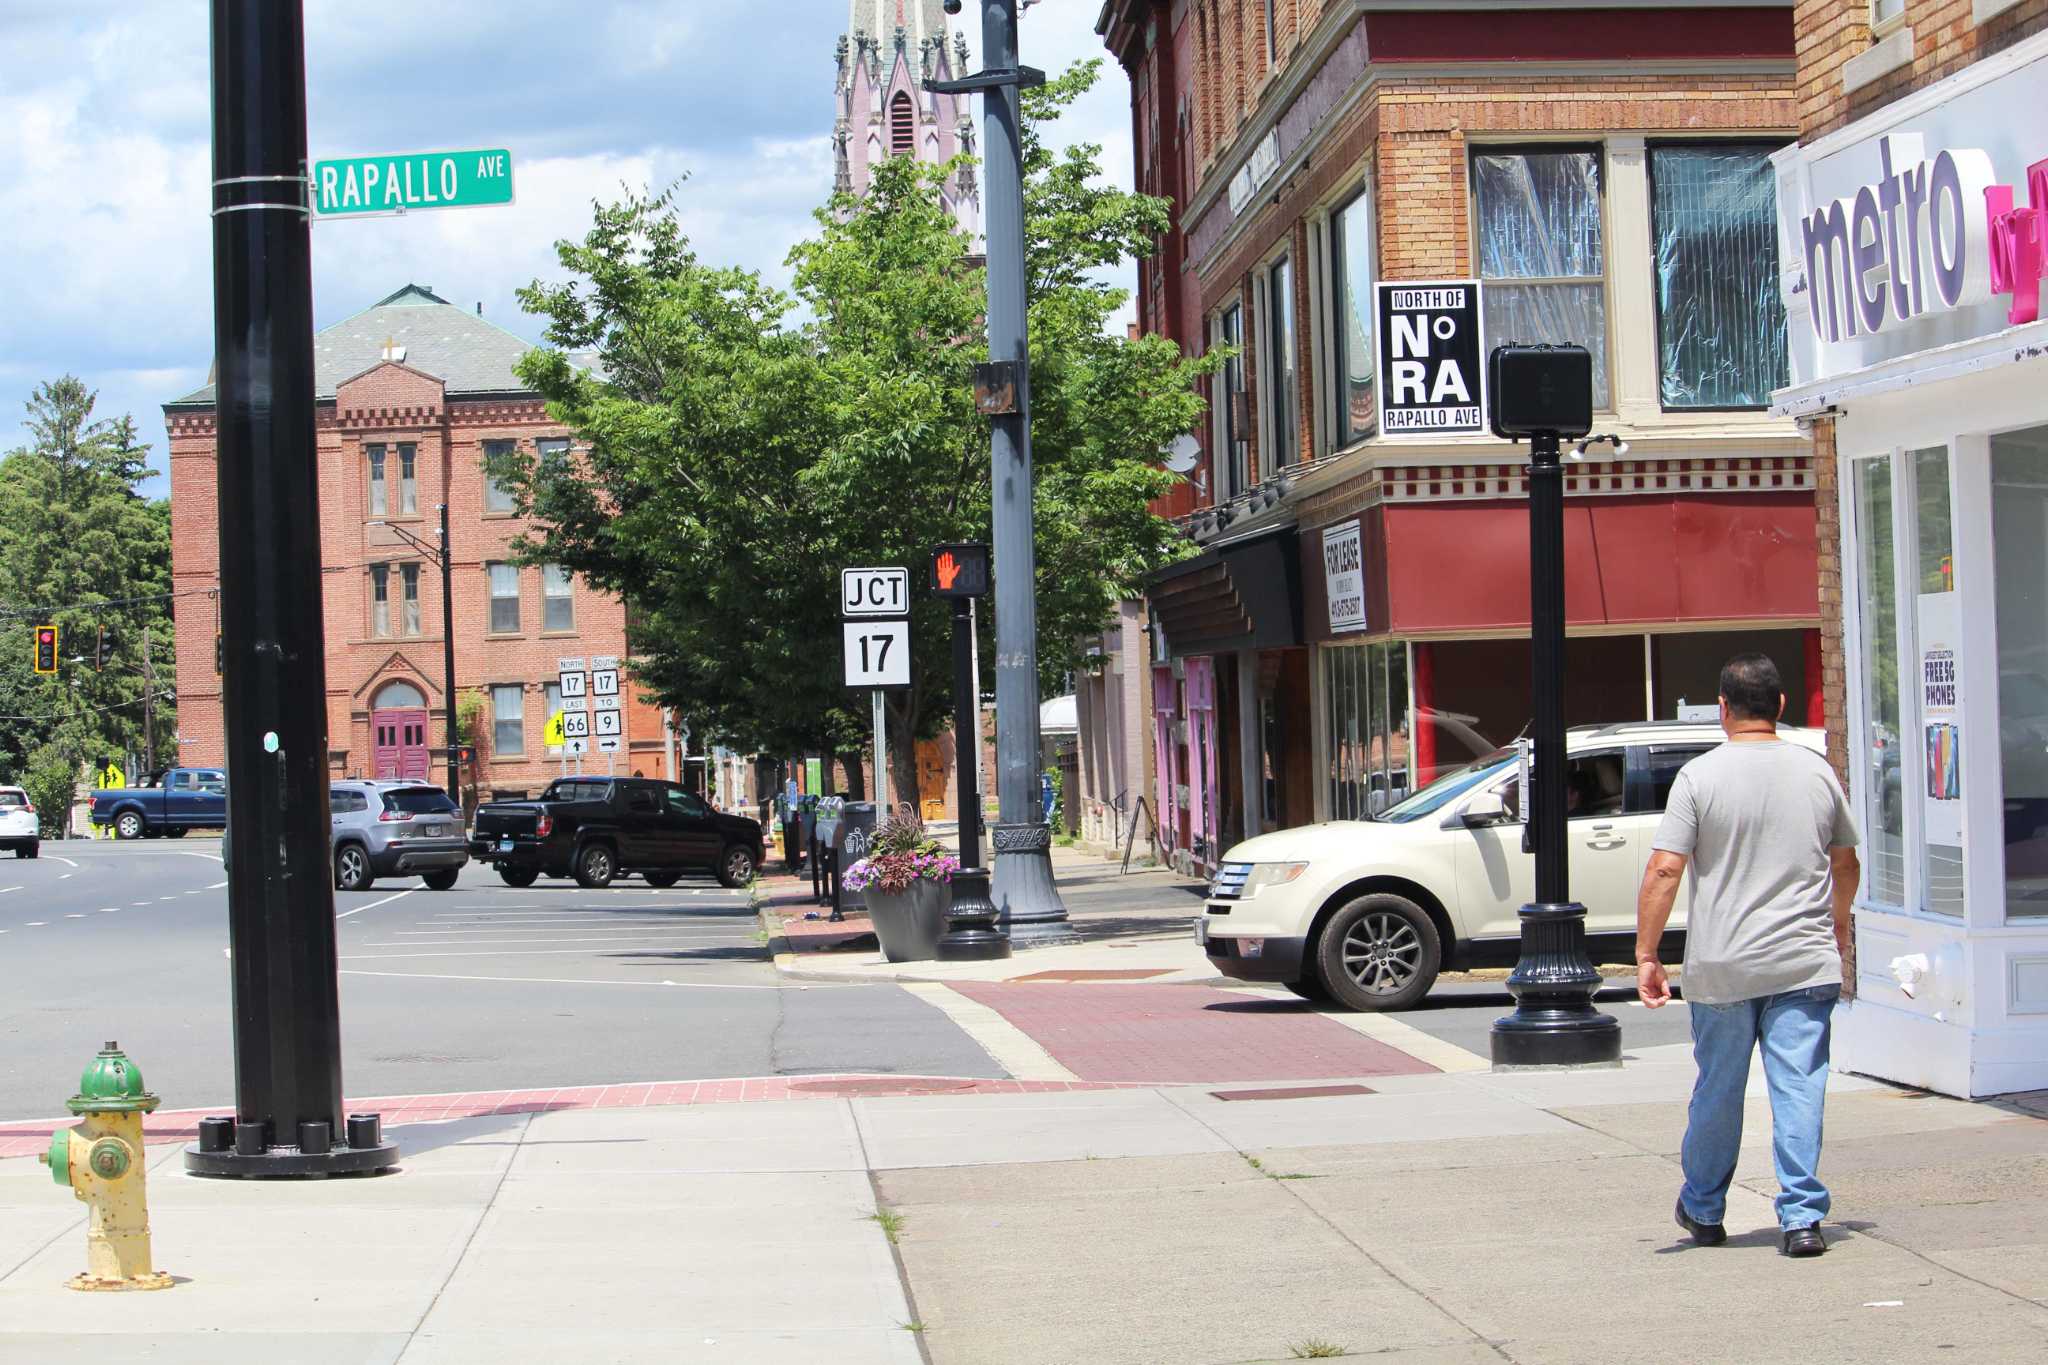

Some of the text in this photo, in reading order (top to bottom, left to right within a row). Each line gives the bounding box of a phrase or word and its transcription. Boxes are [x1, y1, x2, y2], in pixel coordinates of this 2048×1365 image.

[322, 155, 505, 209] RAPALLO AVE
[1802, 132, 1972, 345] metro
[1394, 290, 1462, 308] NORTH OF
[1391, 359, 1471, 405] RA
[1387, 408, 1479, 427] RAPALLO AVE
[1326, 537, 1360, 577] FOR LEASE
[848, 577, 902, 606] JCT
[858, 634, 894, 673] 17
[560, 658, 583, 669] NORTH
[593, 658, 616, 668] SOUTH
[1925, 660, 1955, 683] FREE 5G
[566, 677, 579, 691] 17
[599, 675, 612, 690] 17
[601, 698, 613, 706] TO
[1926, 684, 1956, 706] PHONES
[565, 700, 583, 709] EAST
[567, 718, 585, 732] 66
[603, 715, 612, 729] 9
